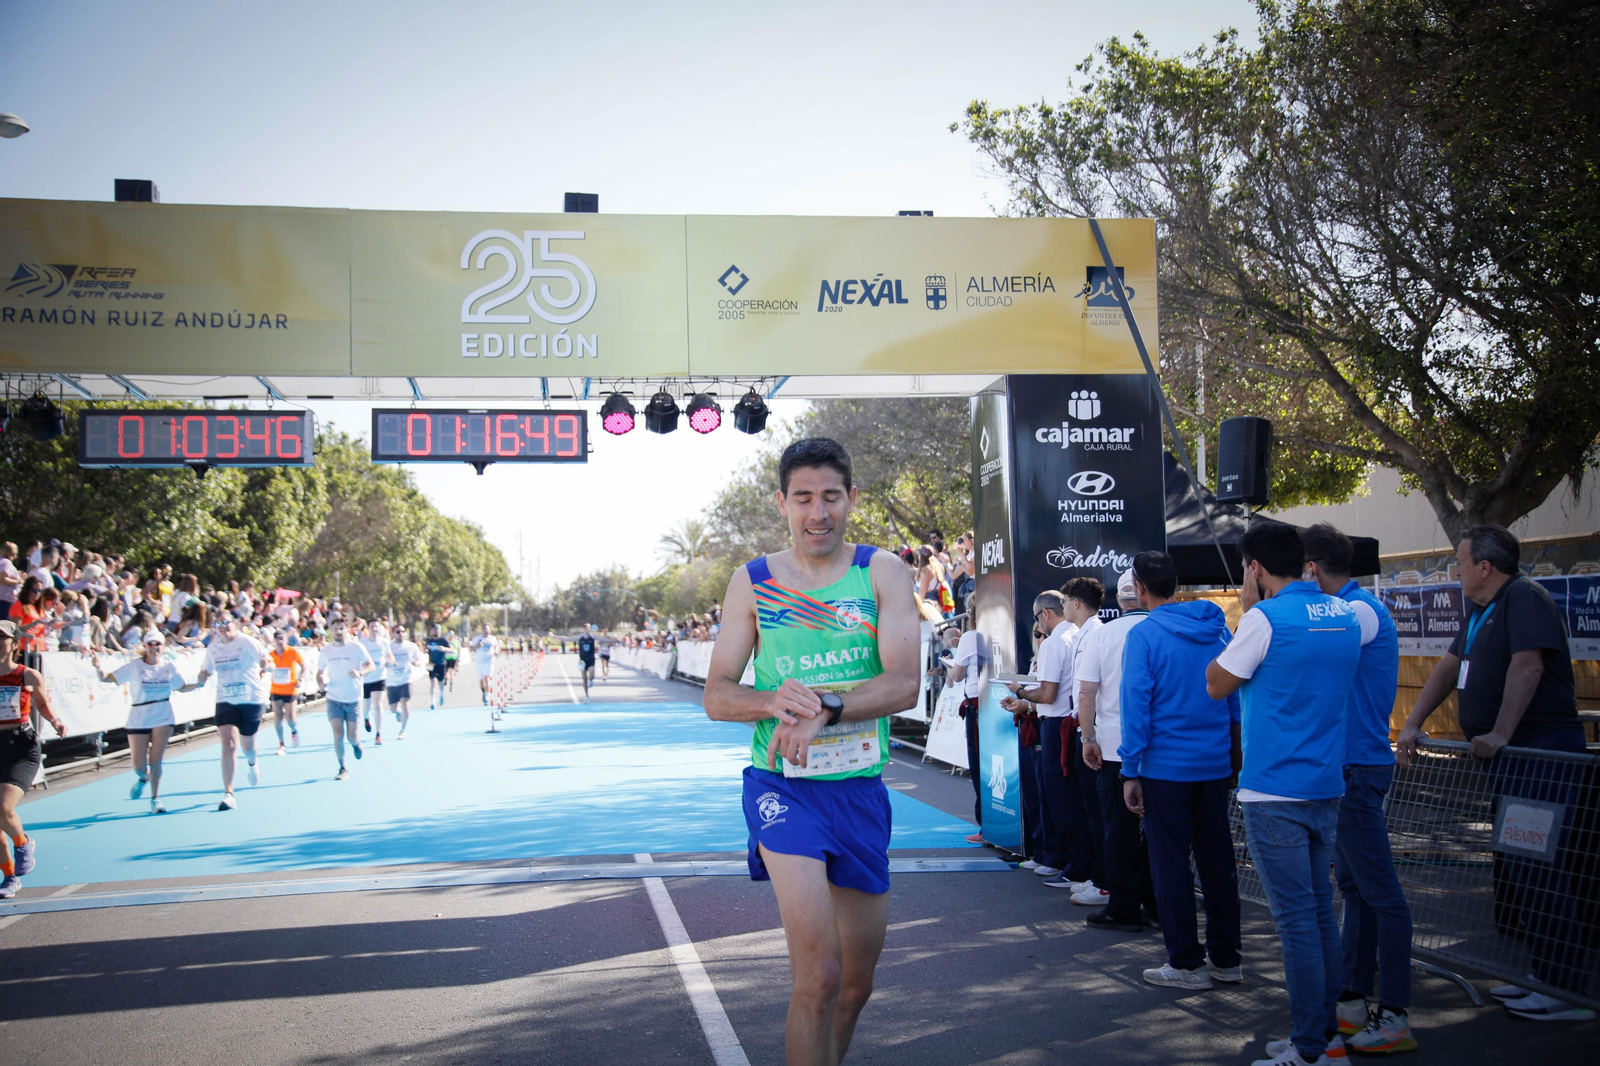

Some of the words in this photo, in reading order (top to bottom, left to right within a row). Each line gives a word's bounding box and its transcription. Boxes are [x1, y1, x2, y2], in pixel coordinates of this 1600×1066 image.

[78, 266, 137, 279] RFEA
[460, 228, 597, 324] 25
[72, 280, 131, 290] SERIES
[966, 272, 1056, 293] ALMERÍA
[68, 291, 104, 299] RUTA
[109, 291, 165, 300] RUNNING
[966, 296, 1012, 307] CIUDAD
[717, 298, 798, 311] COOPERACIÓN
[2, 305, 96, 325] RAMÓN
[107, 310, 164, 327] RUIZ
[174, 309, 288, 329] ANDÚJAR
[718, 310, 745, 320] 2005
[461, 328, 598, 358] EDICIÓN
[118, 415, 302, 458] 01:03:46
[406, 413, 579, 456] 01:16:49
[1035, 421, 1135, 449] cajamar
[1084, 443, 1105, 451] CAJA
[1107, 443, 1133, 451] RURAL
[1058, 500, 1124, 511] HYUNDAI
[1060, 512, 1123, 522] Almerialva
[1396, 618, 1418, 632] lmería
[1428, 617, 1460, 632] Almería
[845, 665, 865, 677] Seed
[829, 722, 864, 733] MORALES
[1503, 826, 1547, 846] EVENTOS
